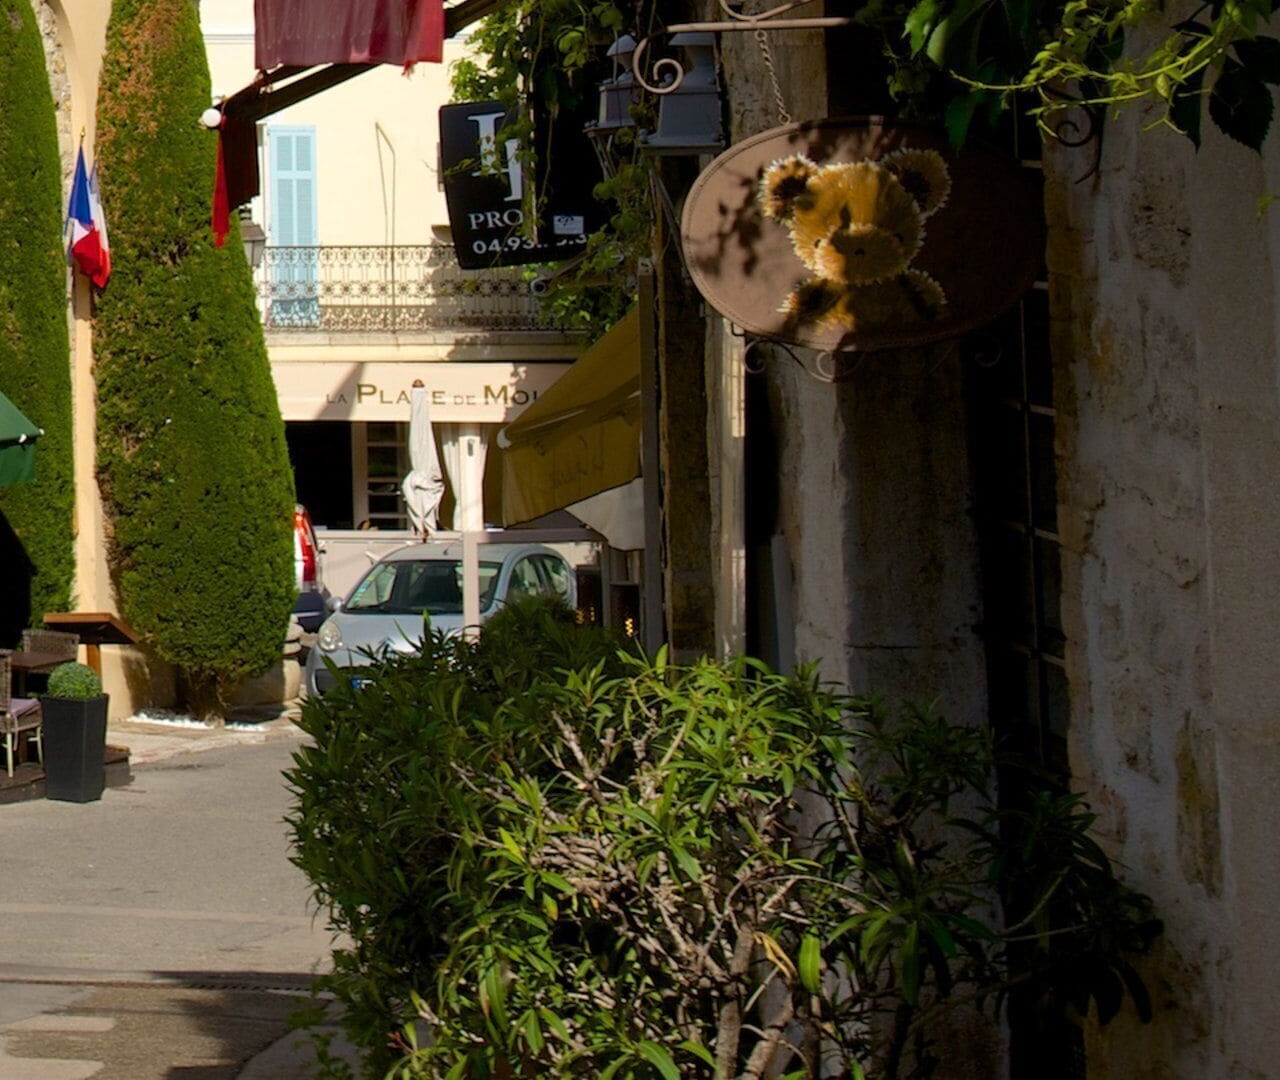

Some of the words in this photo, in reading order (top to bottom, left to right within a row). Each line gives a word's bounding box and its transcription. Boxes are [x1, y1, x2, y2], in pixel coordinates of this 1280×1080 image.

[326, 393, 347, 405] LA
[357, 383, 446, 406] PLAE
[453, 394, 476, 405] DE
